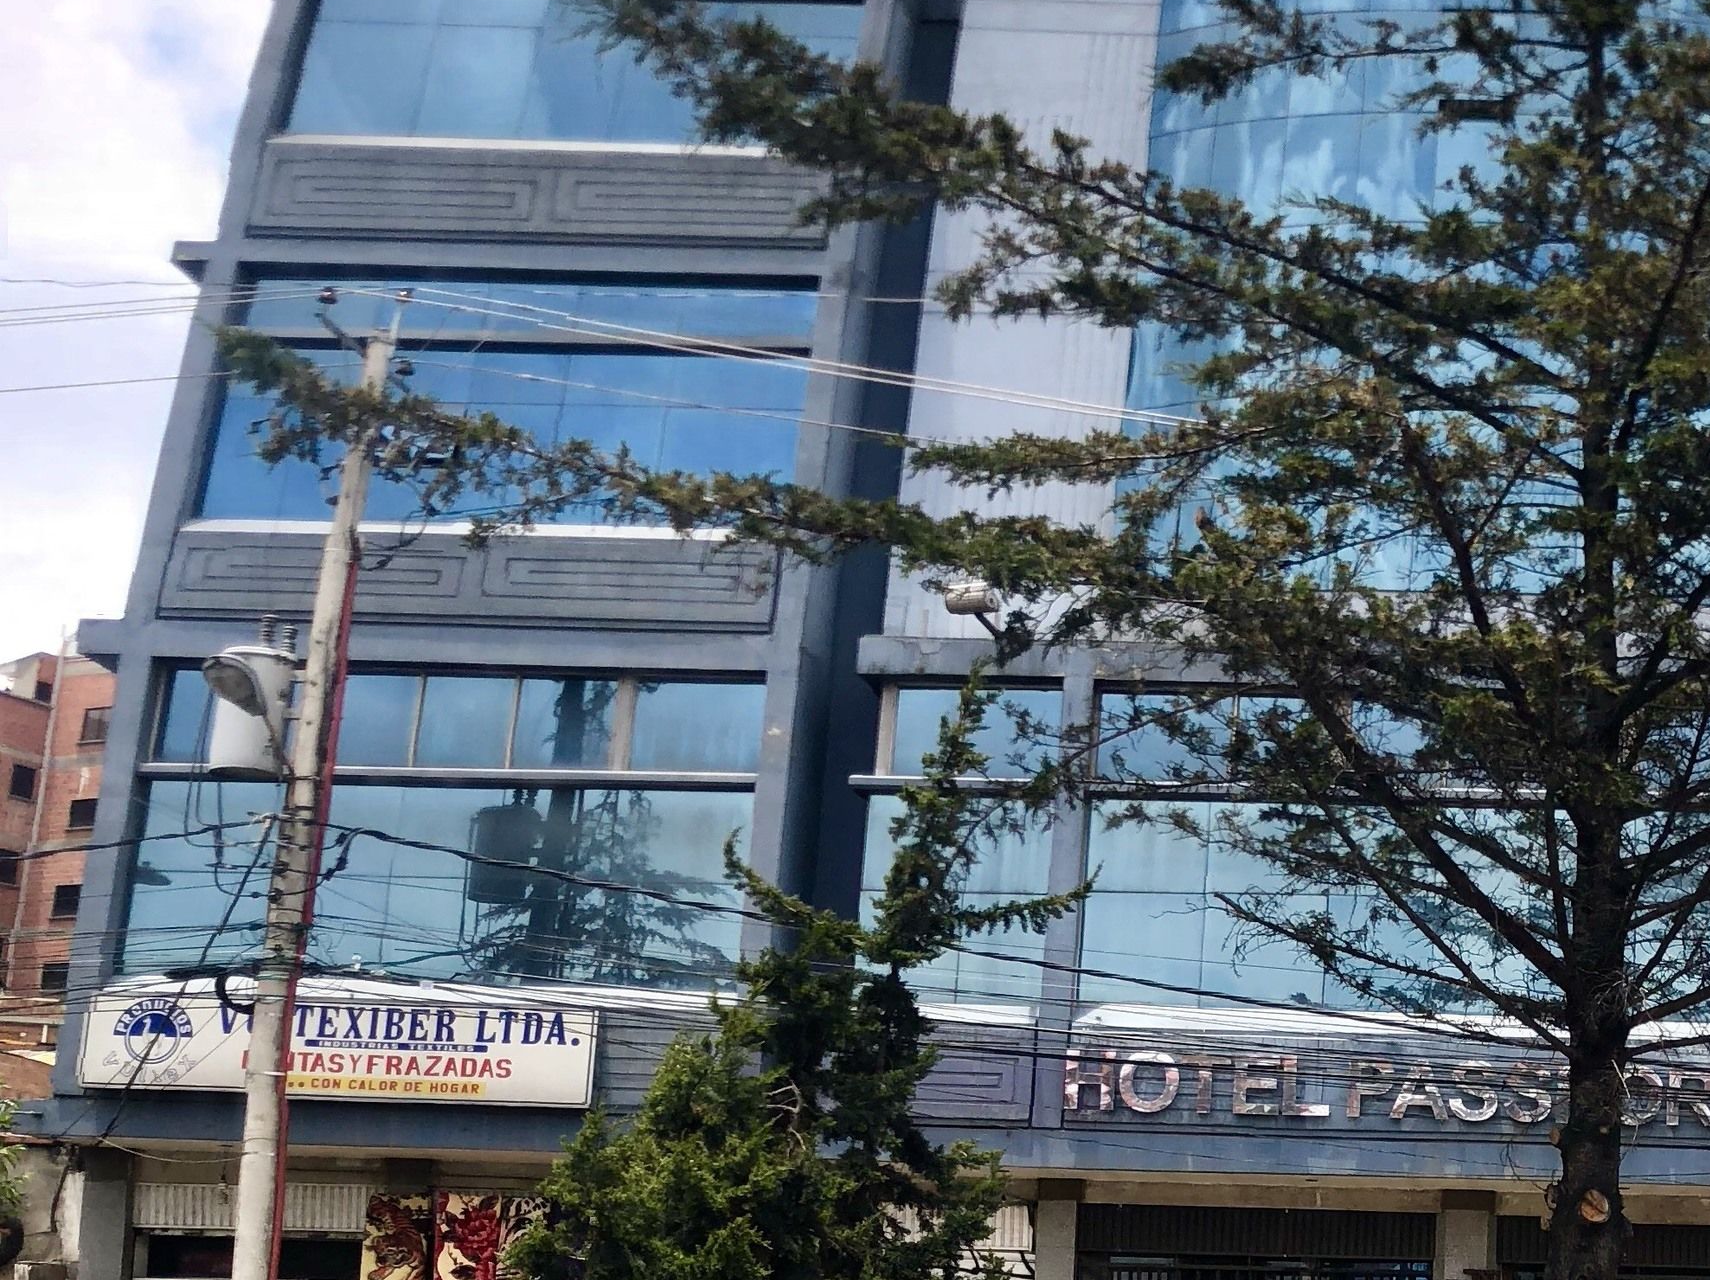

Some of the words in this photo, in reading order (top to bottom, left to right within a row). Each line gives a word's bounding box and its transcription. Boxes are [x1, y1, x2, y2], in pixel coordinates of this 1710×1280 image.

[219, 1002, 456, 1043] VTEXIBER
[366, 1053, 513, 1080] FRAZADAS
[1063, 1047, 1330, 1117] HOTEL
[310, 1078, 342, 1090] CON
[347, 1079, 398, 1092] CALOR
[404, 1081, 421, 1092] DE
[429, 1081, 481, 1095] HOGAR
